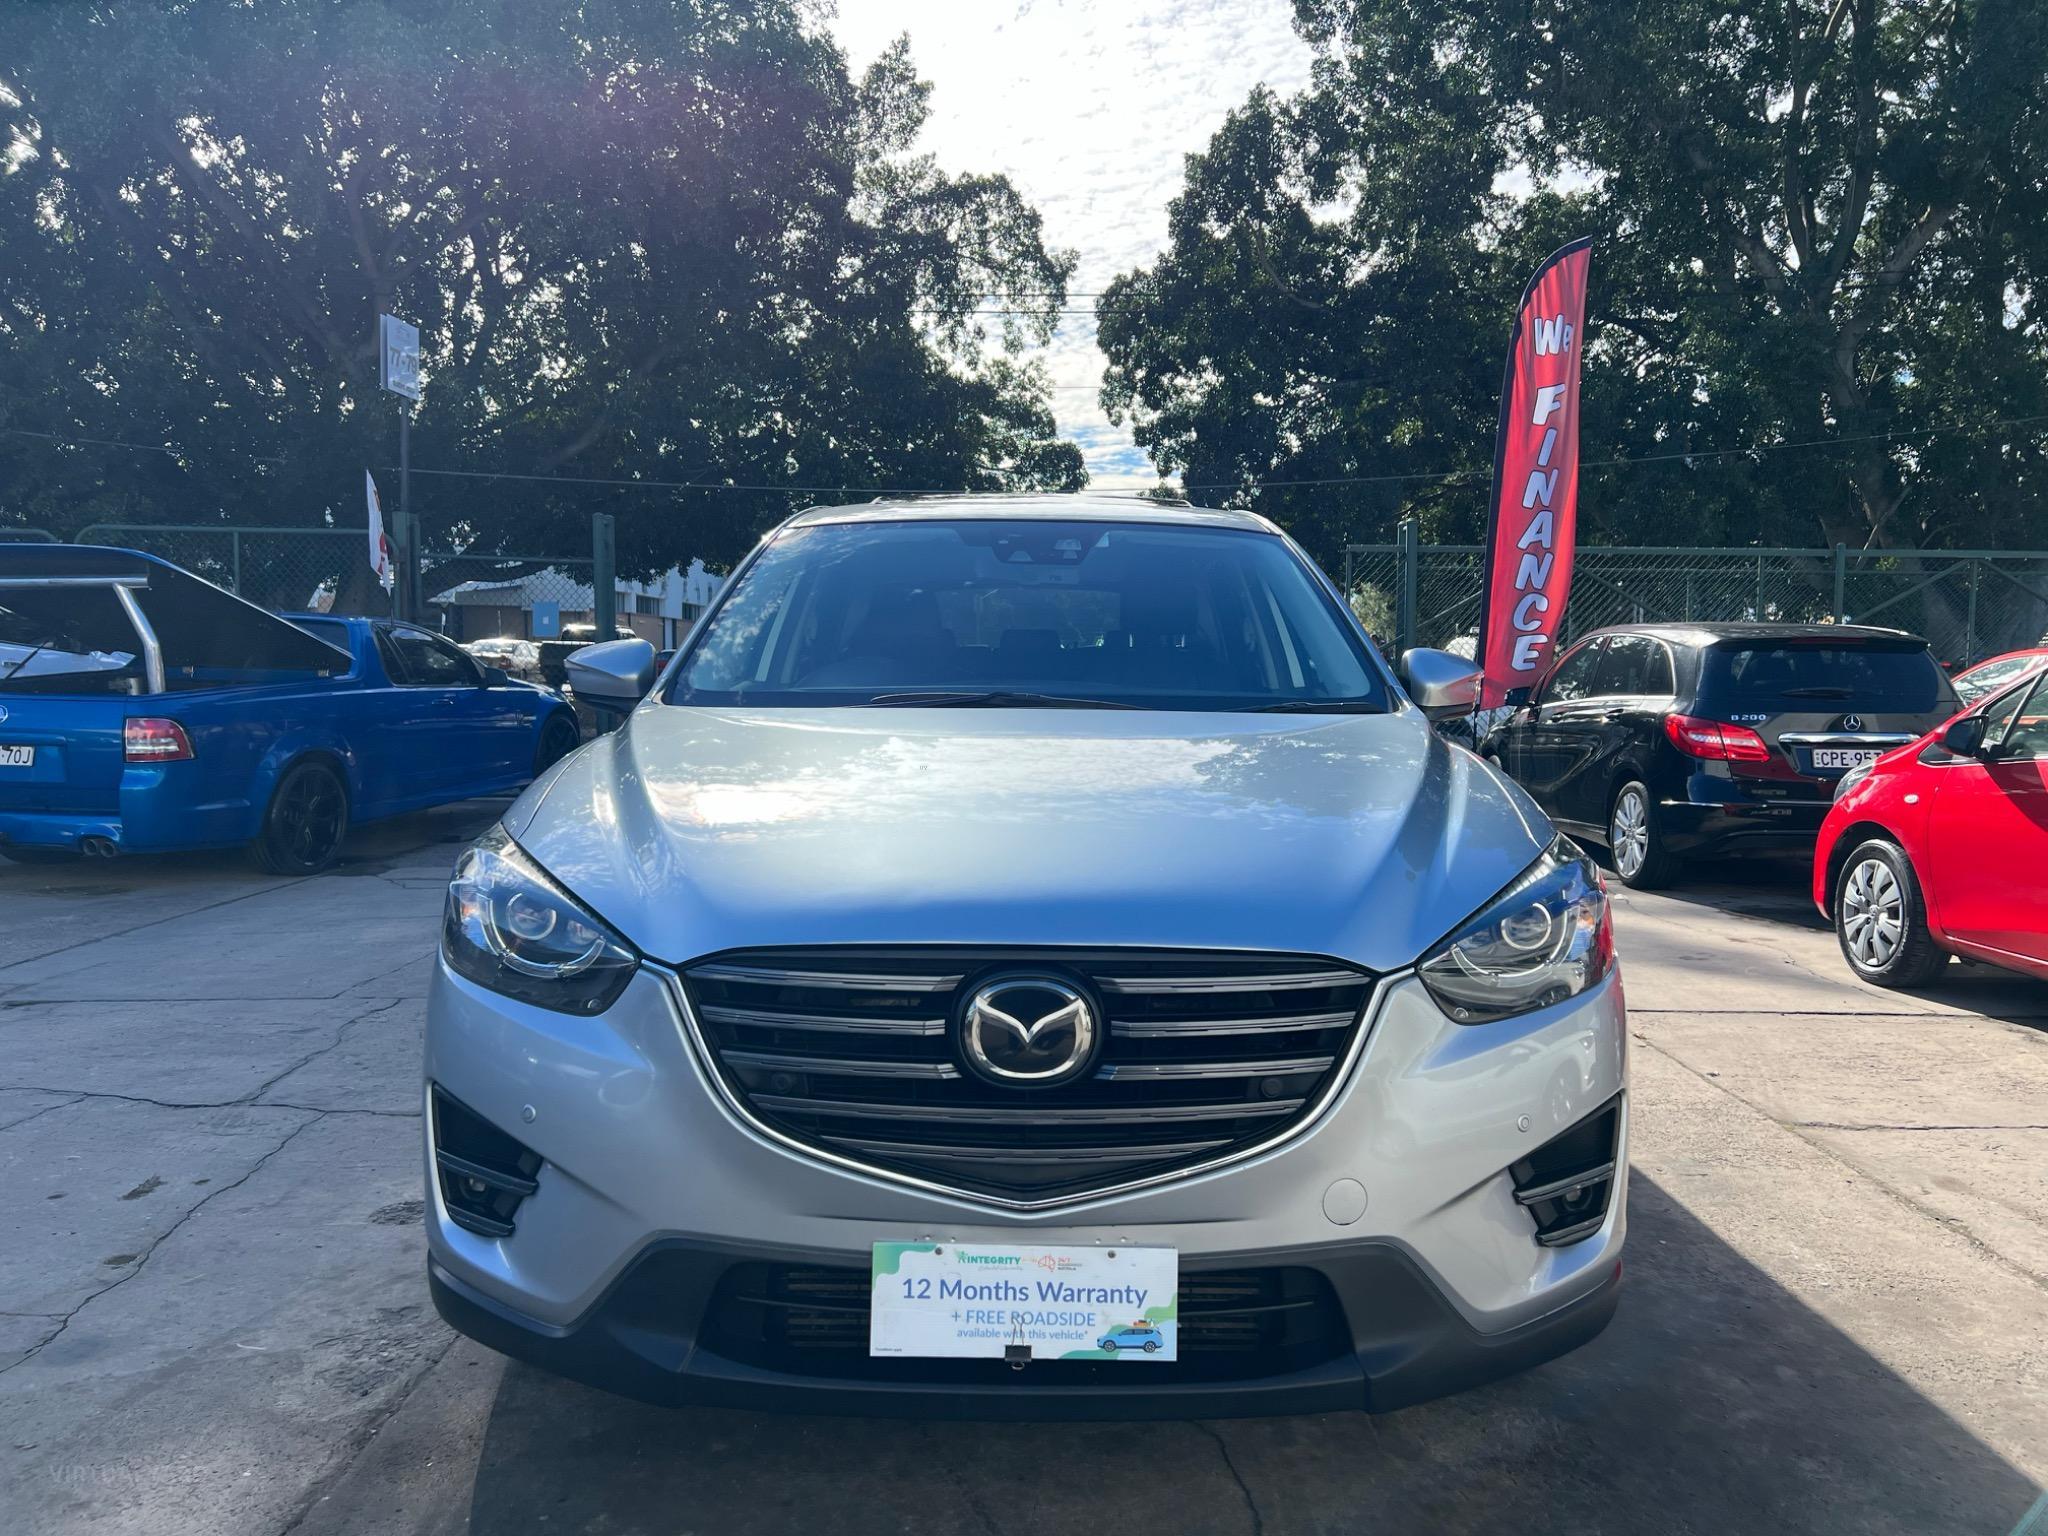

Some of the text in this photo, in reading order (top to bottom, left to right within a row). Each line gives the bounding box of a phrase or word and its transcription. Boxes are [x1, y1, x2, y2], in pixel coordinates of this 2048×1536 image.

[1533, 314, 1573, 357] We
[1510, 384, 1566, 671] FINANCE
[967, 1255, 1022, 1265] INTEGRITY
[902, 1278, 1148, 1308] 12 Months Warranty
[966, 1310, 1005, 1324] FREE
[1010, 1310, 1096, 1327] ROADSIDE
[957, 1329, 1000, 1339] available
[1029, 1330, 1044, 1340] this
